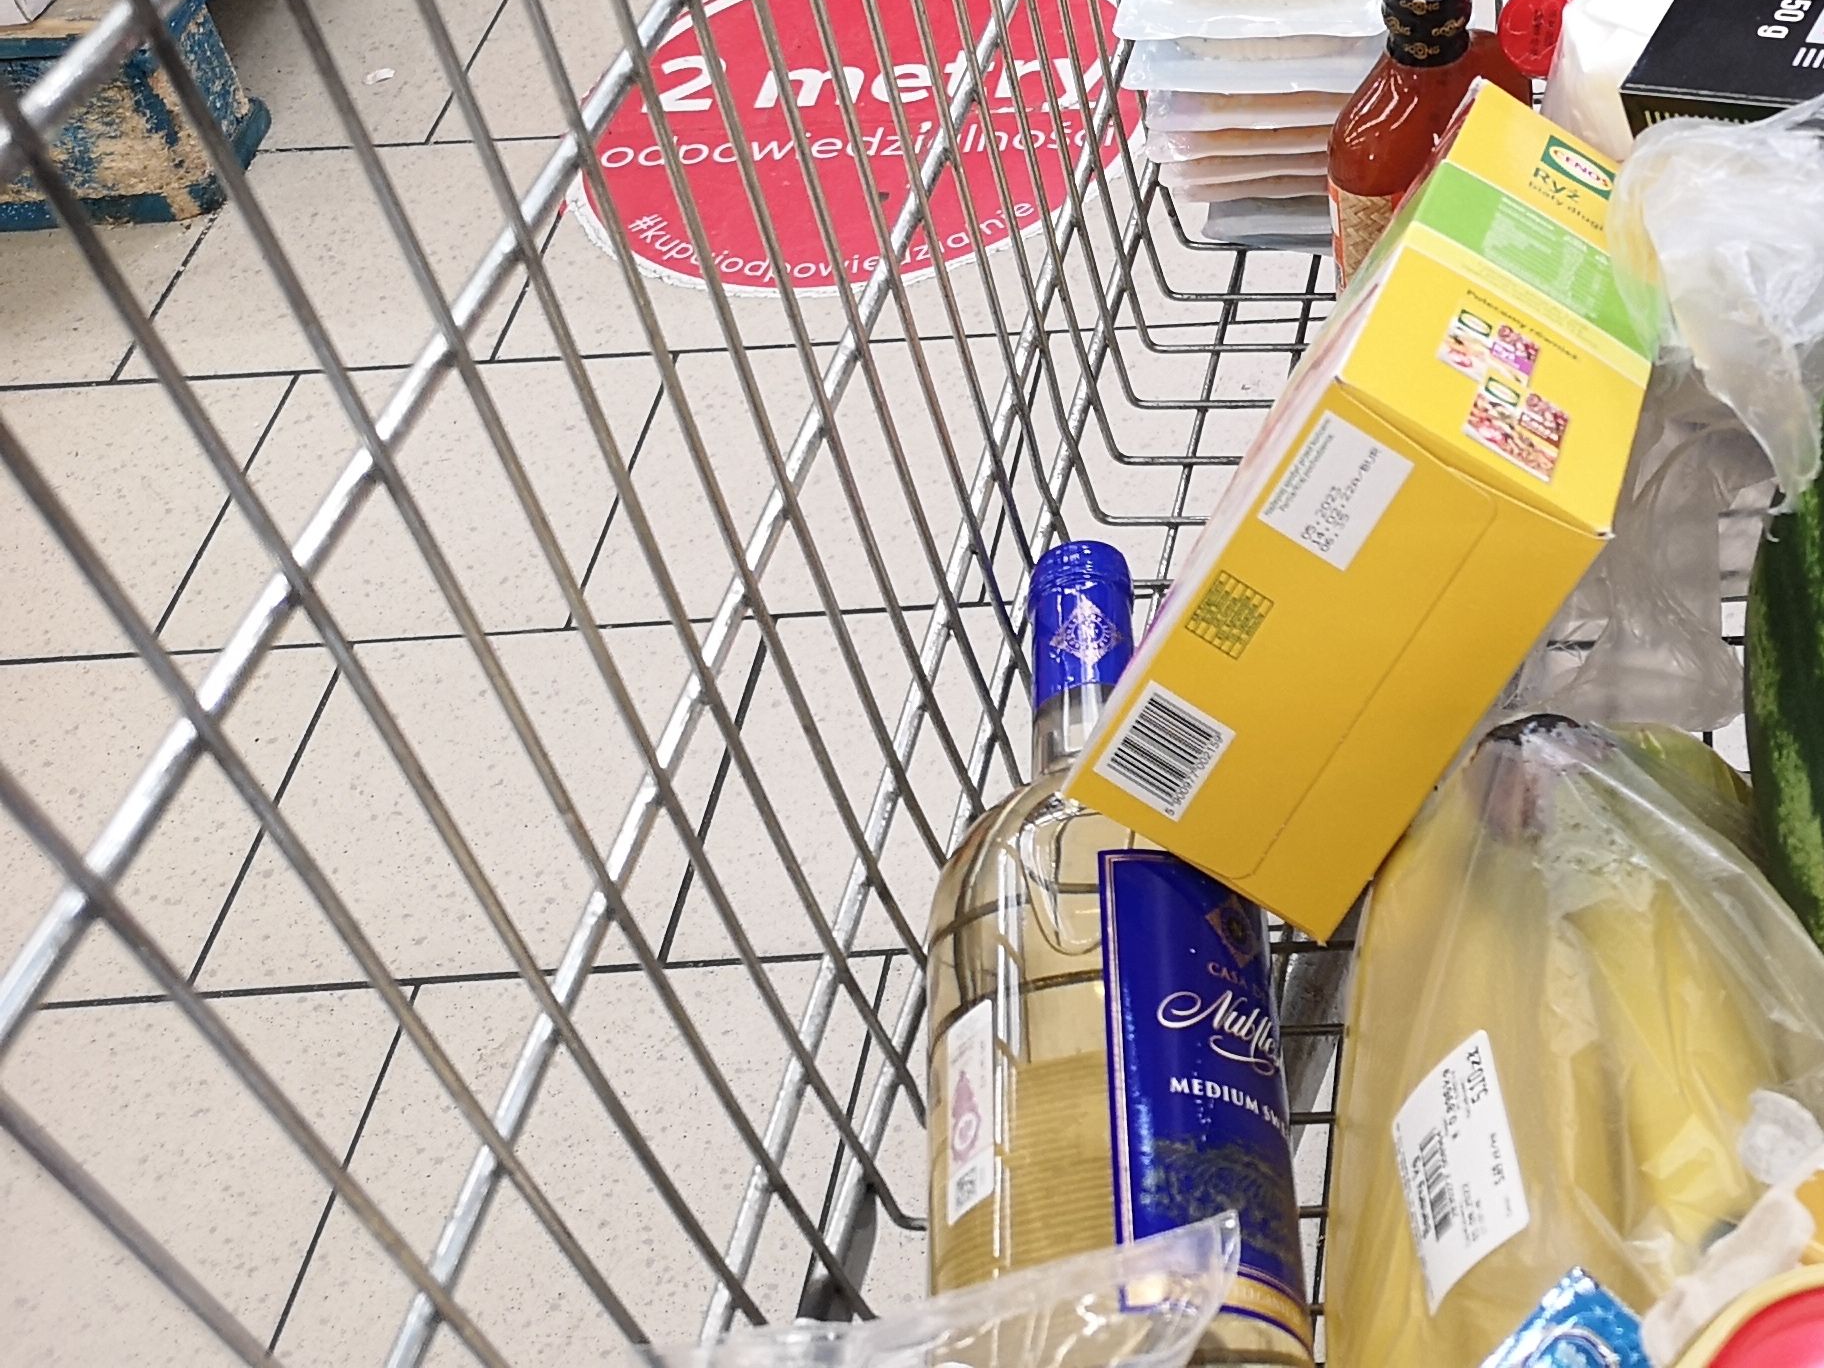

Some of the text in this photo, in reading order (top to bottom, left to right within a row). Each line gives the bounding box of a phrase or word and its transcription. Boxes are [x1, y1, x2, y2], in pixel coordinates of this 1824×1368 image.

[1756, 24, 1790, 39] g
[641, 48, 1104, 113] 2 metry
[600, 119, 1117, 169] odpowedzilności
[1532, 166, 1581, 203] Ryż
[1207, 961, 1248, 990] CASA
[1168, 1076, 1260, 1115] MEDIUM
